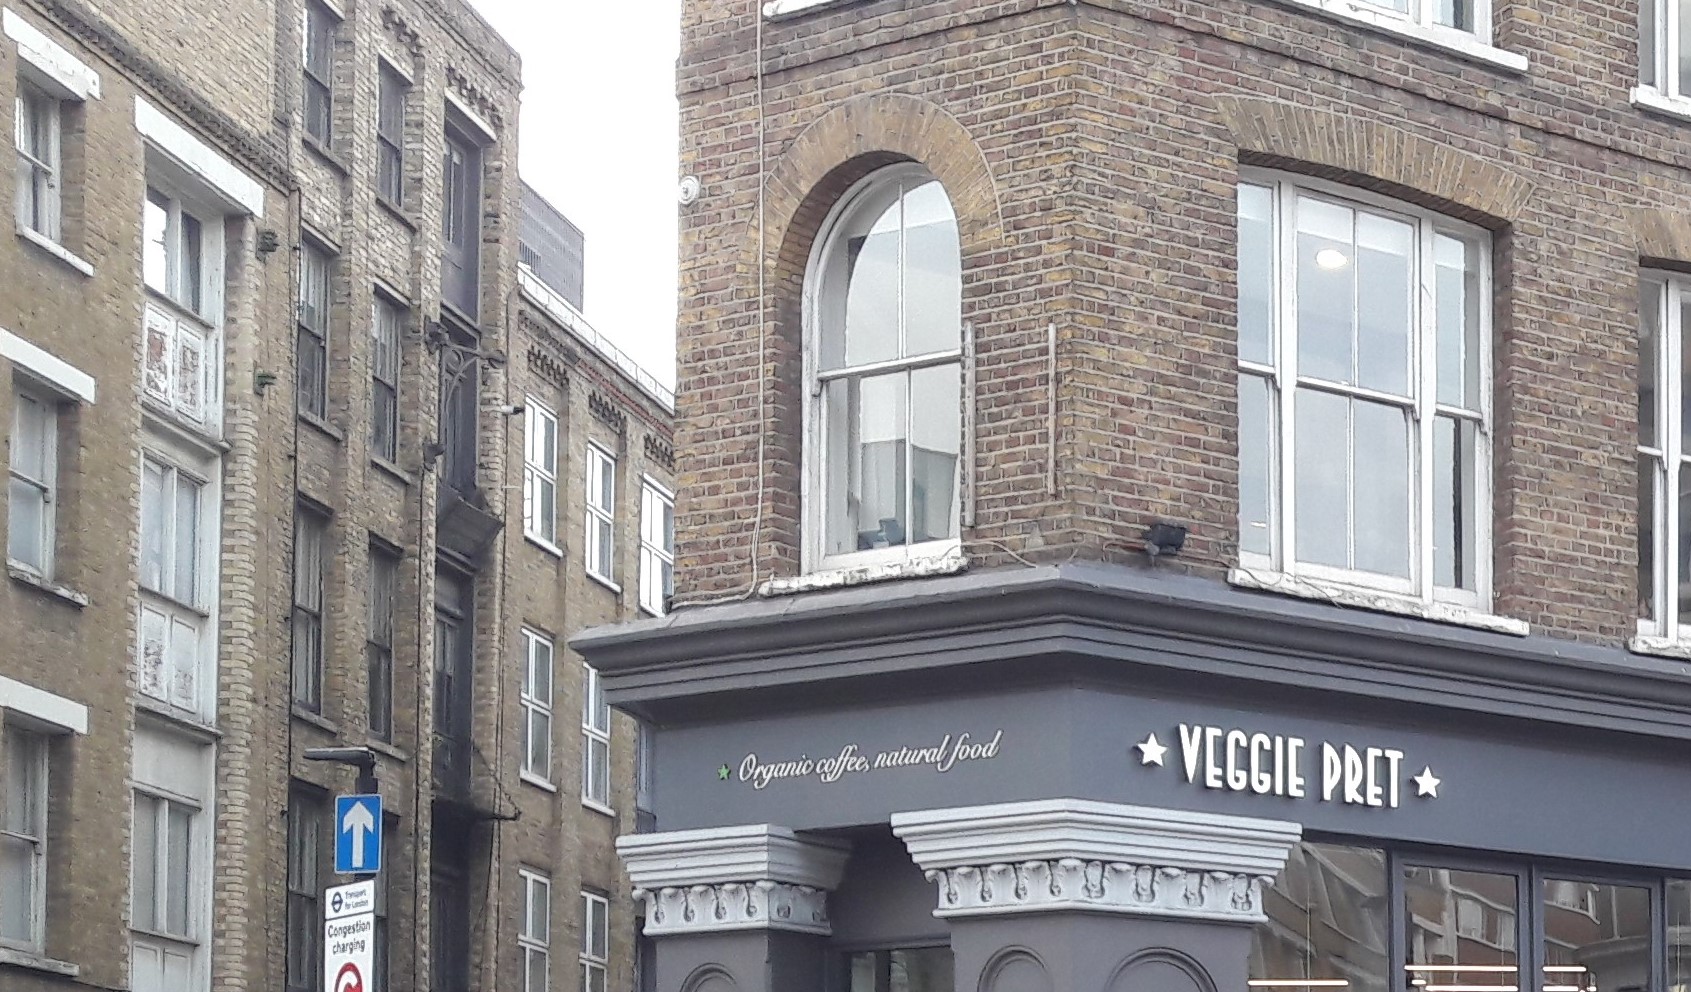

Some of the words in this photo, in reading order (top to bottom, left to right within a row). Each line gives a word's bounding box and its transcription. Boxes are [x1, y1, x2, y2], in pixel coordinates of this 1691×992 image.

[739, 753, 815, 790] Organic
[816, 744, 870, 783] coffee,
[873, 734, 952, 769] natural
[937, 730, 1003, 773] food
[1178, 723, 1305, 798] VEGGIE
[1321, 740, 1404, 808] PRET
[327, 920, 371, 938] Congestion
[332, 938, 366, 955] charging
